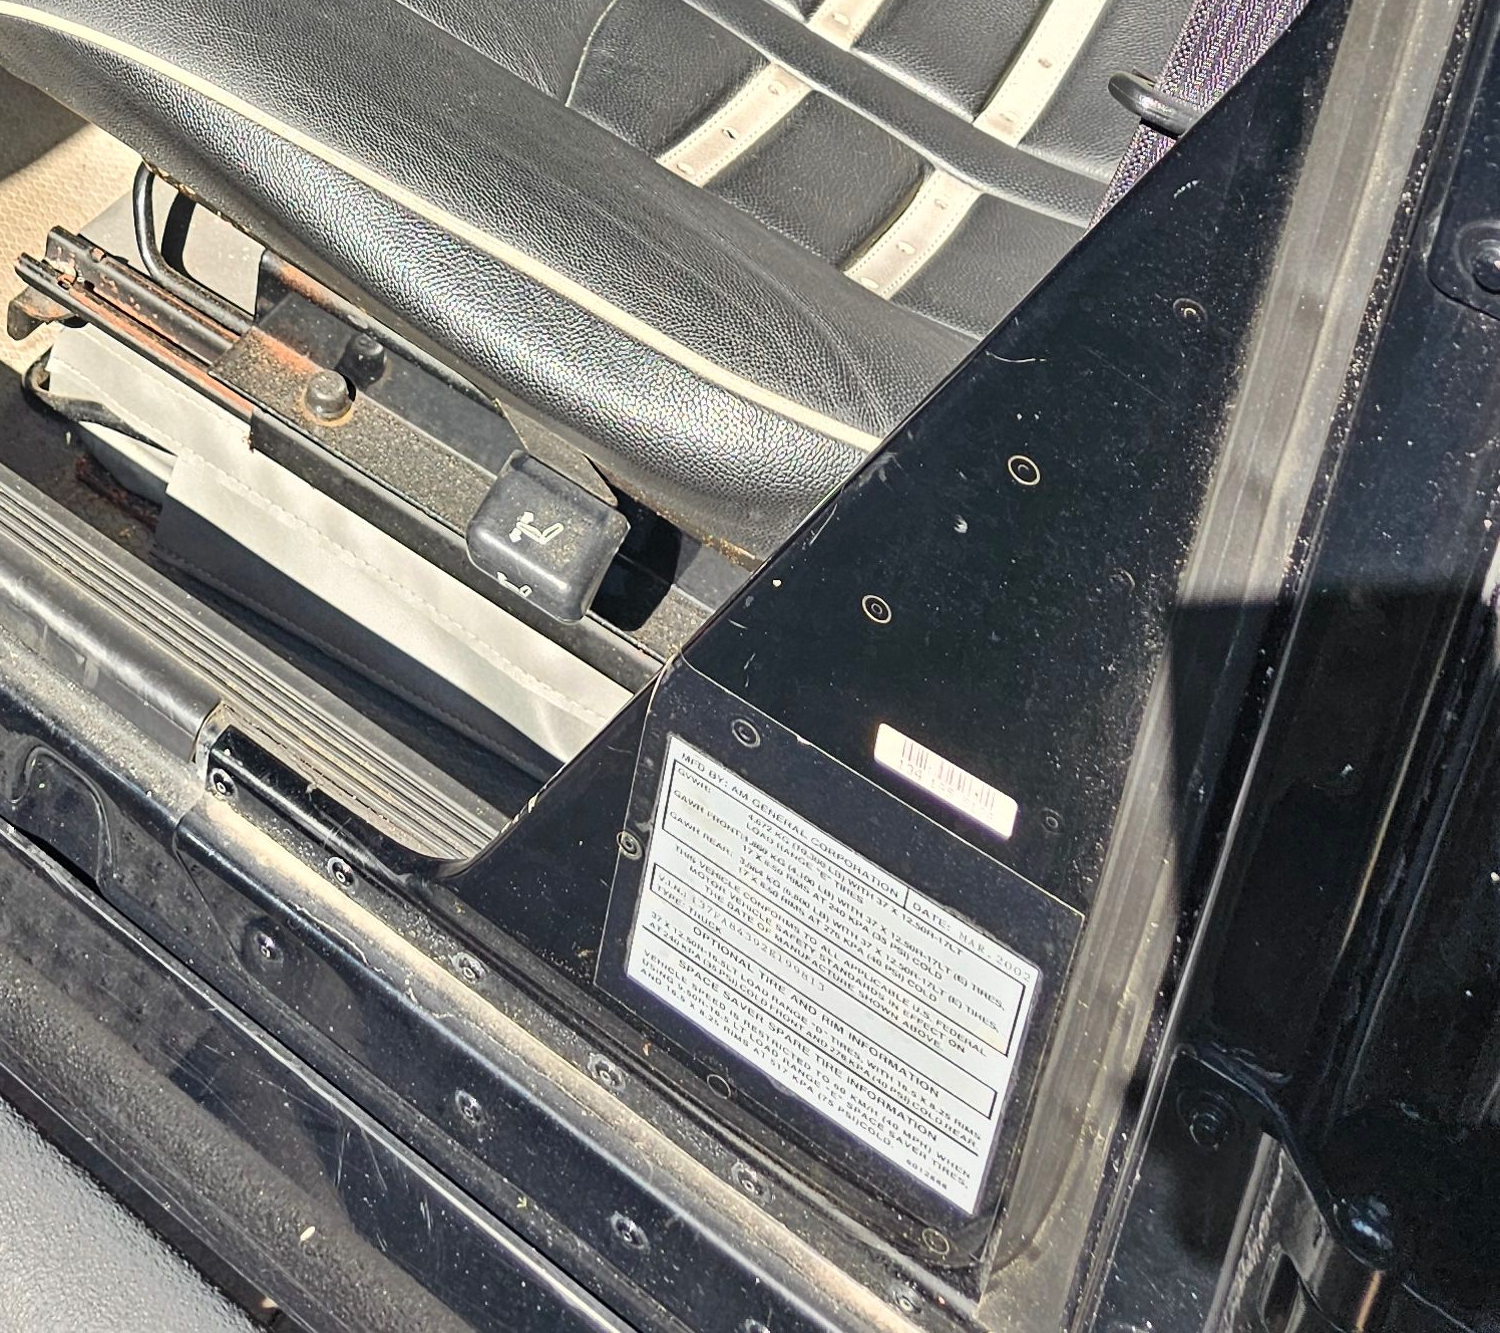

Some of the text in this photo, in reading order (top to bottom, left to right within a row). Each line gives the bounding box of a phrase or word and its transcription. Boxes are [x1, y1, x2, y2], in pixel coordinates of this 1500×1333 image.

[680, 751, 899, 899] MFD BY: AM GENERAL CORPORATION
[745, 822, 773, 846] LOAD
[833, 879, 864, 905] TIRES
[687, 904, 723, 935] TRUCK
[831, 917, 858, 942] WITH
[836, 895, 864, 920] WITH
[846, 877, 874, 901] WITH
[847, 913, 870, 934] KPA
[911, 955, 943, 982] COLD
[911, 900, 951, 933] DATE:
[688, 863, 727, 896] MOTOR
[729, 891, 772, 927] VEHICLE
[774, 922, 816, 956] SAFETY
[818, 951, 886, 1002] STANDARDS
[902, 1007, 946, 1042] EFFECT
[946, 1037, 966, 1055] ON
[692, 924, 940, 1099] OPTIONAL TIRE AND RIM INFORMATION
[698, 860, 741, 894] VEHICLE
[742, 890, 800, 935] CONFORMS
[820, 942, 838, 960] ALL
[842, 957, 910, 1008] APPLICABLE
[935, 1018, 987, 1058] FEDERAL
[703, 884, 725, 905] THE
[726, 899, 755, 925] DATE
[773, 931, 854, 992] MANUFACTURE
[857, 988, 899, 1022] SHOWN
[841, 935, 865, 956] KPA
[905, 977, 937, 1004] COLD
[639, 965, 662, 987] AND
[791, 1072, 815, 1094] KPA
[643, 948, 688, 985] VEHICLE
[690, 981, 726, 1012] SPEED
[742, 1017, 812, 1071] RESTRICTED
[934, 1150, 971, 1181] WHEN
[678, 958, 938, 1143] SPACE SAVER SPARE TIRE INFORMATION
[739, 971, 769, 998] LOAD
[770, 993, 808, 1025] RANGE
[865, 1058, 895, 1083] WITH
[748, 1032, 779, 1059] LOAD
[781, 1055, 821, 1088] RANGE
[845, 1099, 885, 1132] SPACE
[887, 1128, 927, 1161] SAVER
